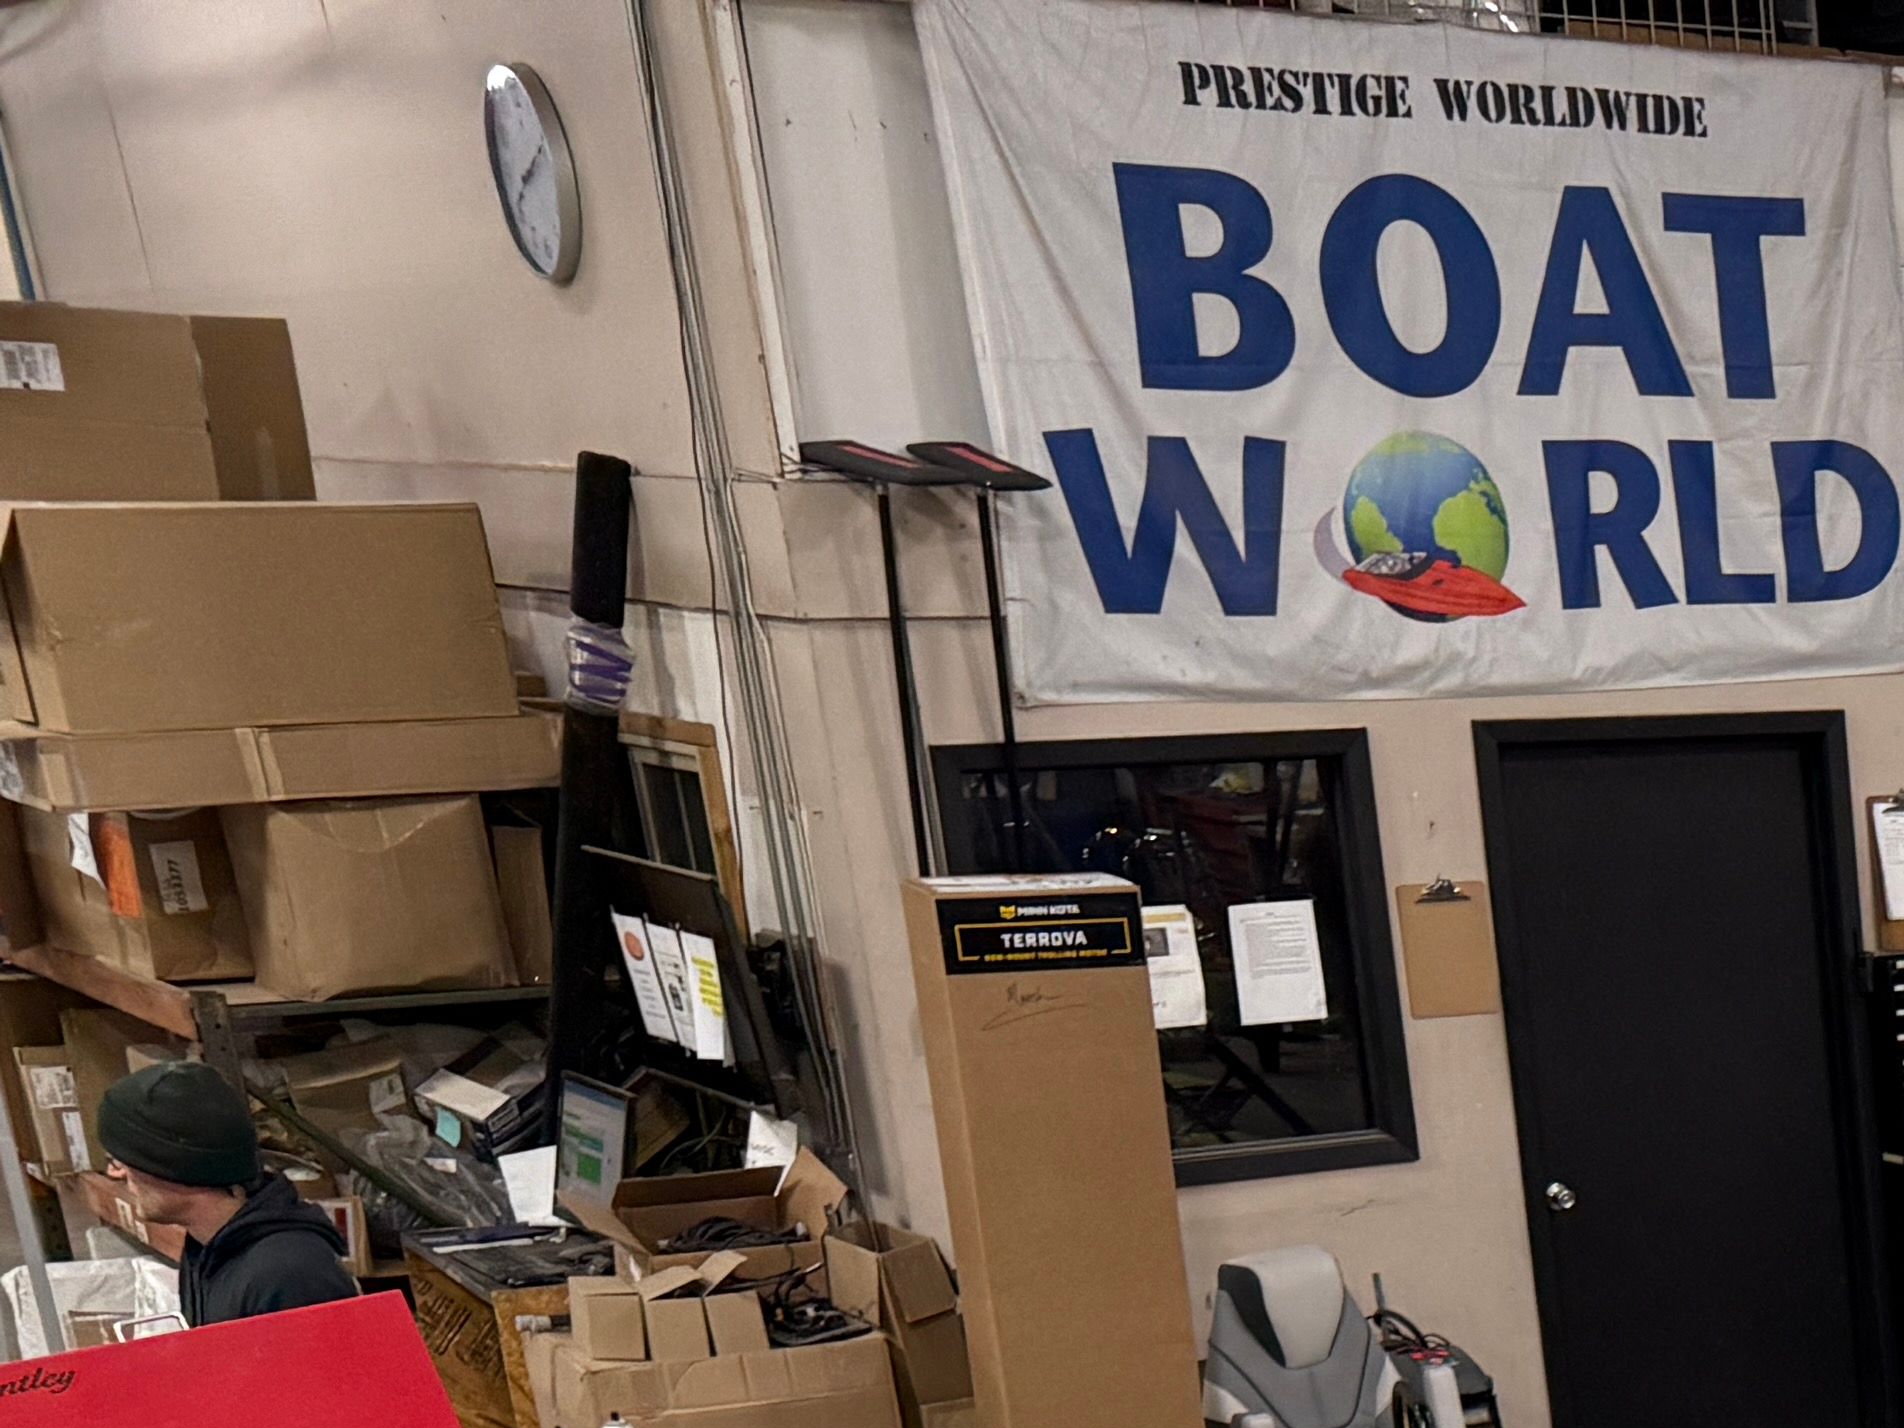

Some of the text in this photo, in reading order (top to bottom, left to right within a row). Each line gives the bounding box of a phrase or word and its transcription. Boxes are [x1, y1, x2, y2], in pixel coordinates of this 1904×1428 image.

[1177, 61, 1709, 138] PRESTIGE WORLDWIDE
[1112, 160, 1806, 399] BOAT
[1000, 930, 1088, 949] TERROVA
